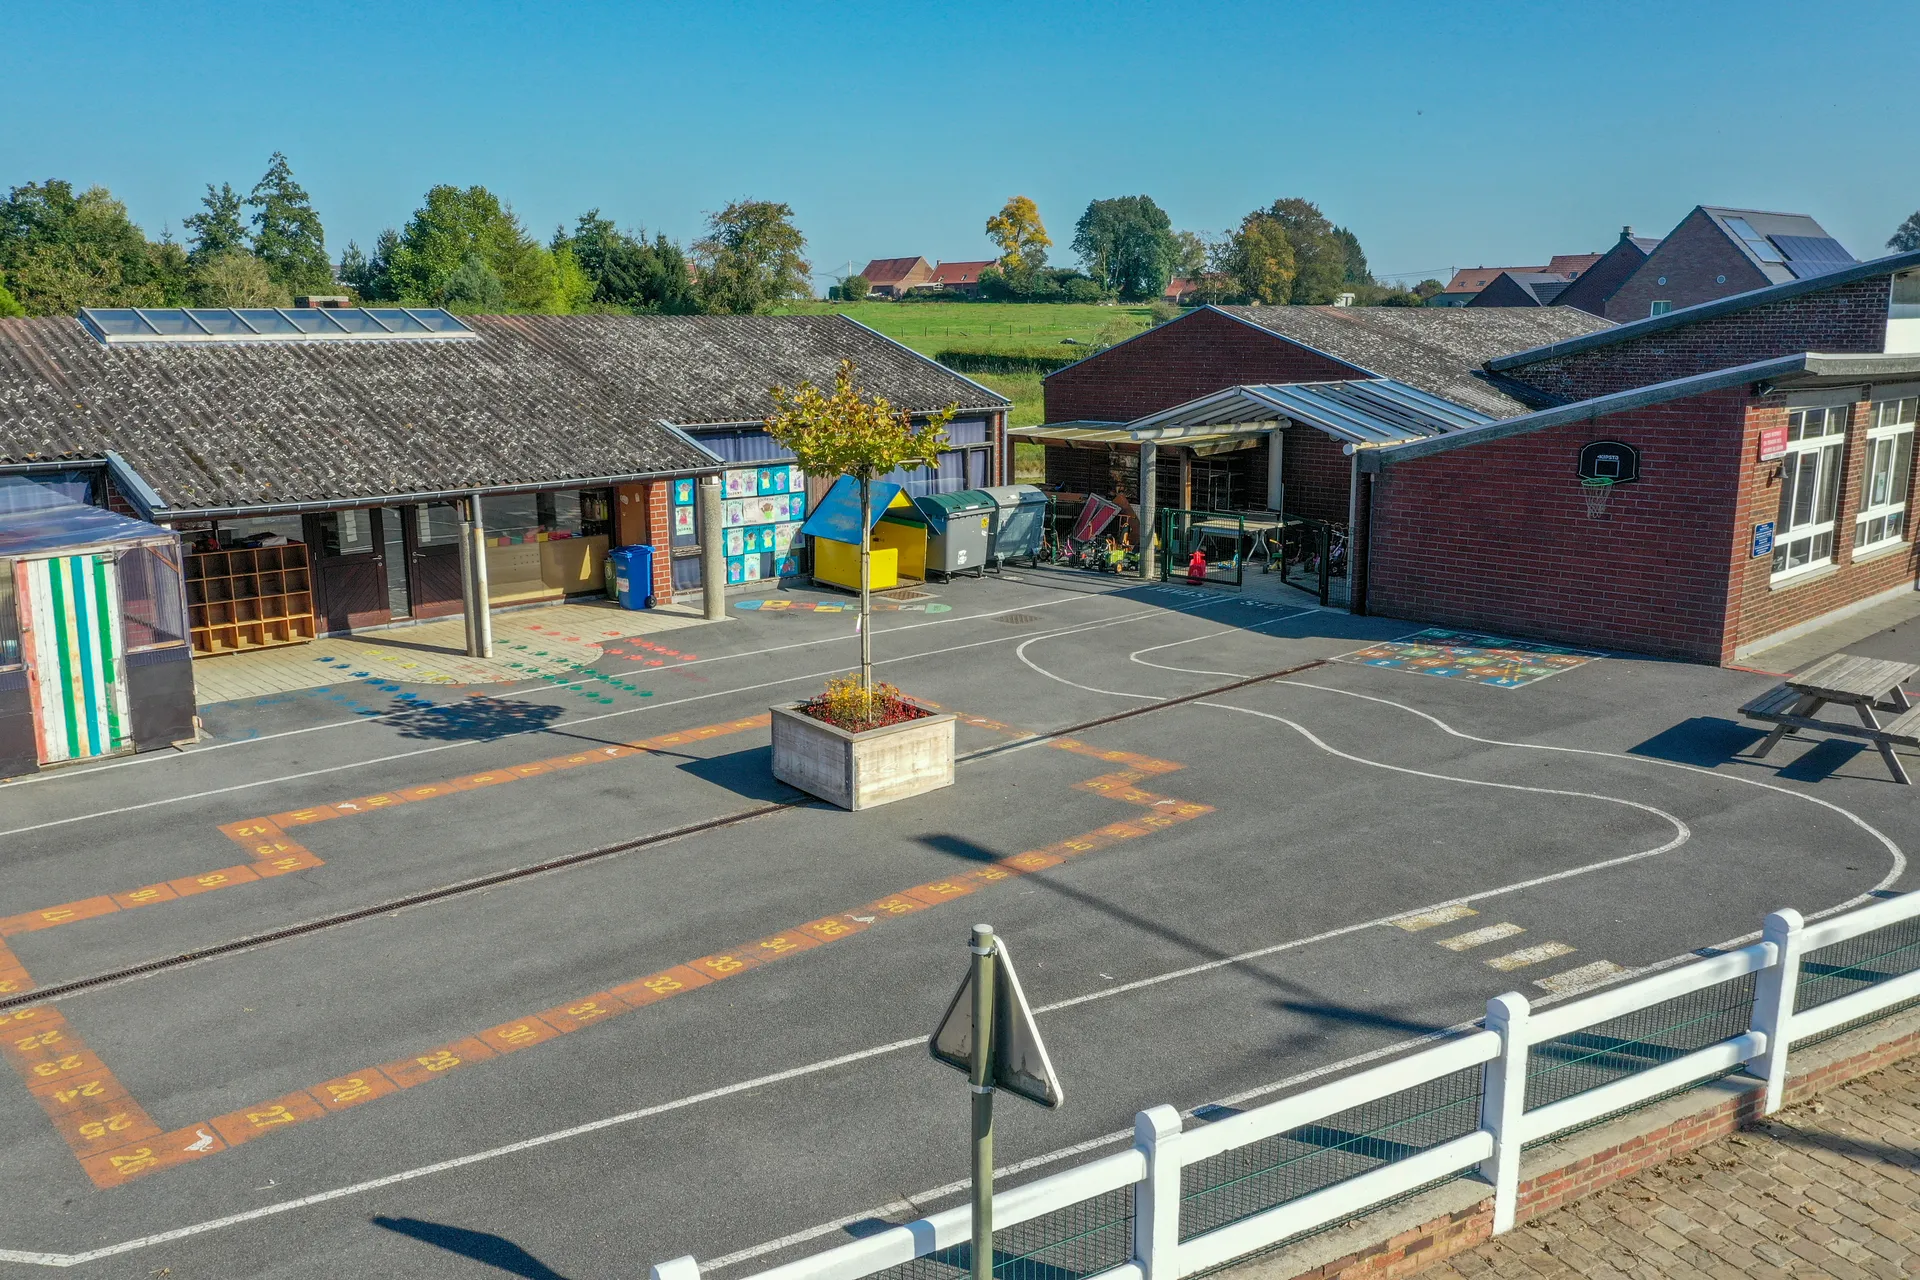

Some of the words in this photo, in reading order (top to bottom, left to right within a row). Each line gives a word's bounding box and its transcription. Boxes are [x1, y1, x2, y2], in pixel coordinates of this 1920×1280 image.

[235, 826, 267, 837] 12
[197, 874, 228, 887] 15
[928, 882, 964, 895] 37
[878, 899, 913, 914] 36
[813, 919, 850, 936] 35
[760, 937, 797, 954] 34
[705, 956, 743, 972] 33
[644, 976, 683, 994] 32
[14, 1030, 62, 1051] 22
[498, 1024, 537, 1044] 30
[33, 1054, 83, 1077] 23
[416, 1050, 461, 1072] 29
[54, 1080, 105, 1103] 24
[326, 1078, 372, 1101] 28
[78, 1112, 132, 1140] 25
[246, 1105, 295, 1128] 27
[109, 1148, 158, 1175] 26
